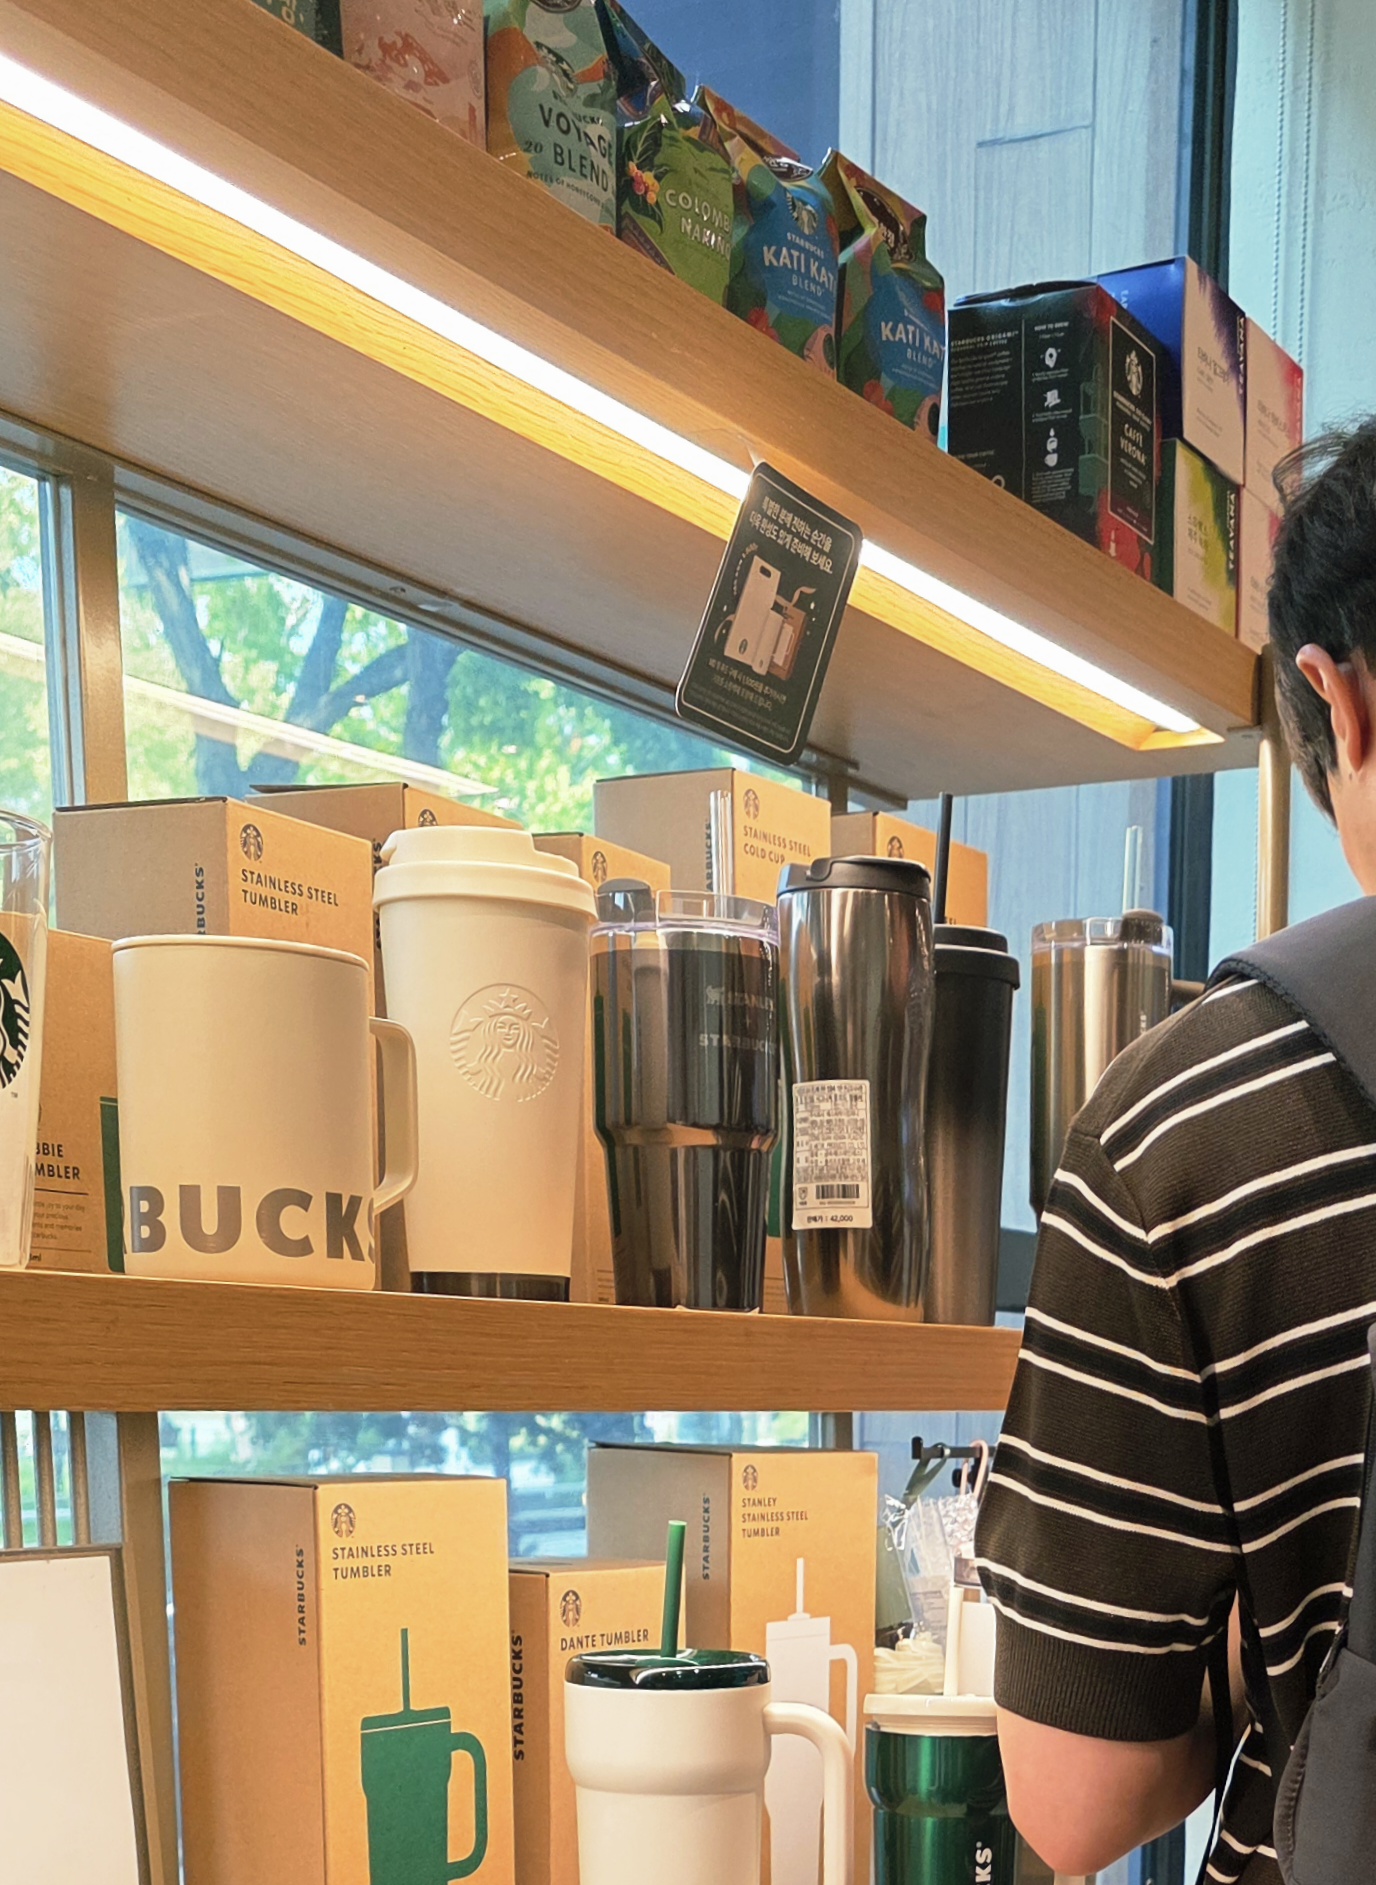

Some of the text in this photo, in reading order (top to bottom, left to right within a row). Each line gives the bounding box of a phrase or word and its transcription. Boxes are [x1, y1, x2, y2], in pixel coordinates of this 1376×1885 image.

[553, 142, 609, 192] BLEND
[665, 189, 732, 232] COLOMB
[763, 246, 806, 273] KATI
[792, 274, 823, 297] BLEND
[881, 321, 945, 361] KATI KAT
[743, 825, 811, 857] STAINLESS STEEL
[743, 843, 785, 864] COLD CUP
[195, 866, 206, 935] BUCKS
[241, 868, 339, 907] STAINLESS STEEL
[241, 889, 299, 916] TUMBLER
[35, 1142, 64, 1158] BBIE
[35, 1164, 81, 1180] MBLER
[124, 1184, 376, 1264] BUCK
[742, 1497, 778, 1508] STANLEY
[742, 1511, 808, 1523] STAINLESS STEEL
[702, 1496, 710, 1580] STARBUCKS
[742, 1527, 780, 1538] TUMBLER
[332, 1542, 435, 1560] STAINLESS STEEL
[332, 1564, 392, 1580] TUMBLER
[296, 1548, 307, 1646] STARBUCKS
[560, 1629, 649, 1651] DANTE TUMBLER
[511, 1634, 525, 1761] STARBUCKS
